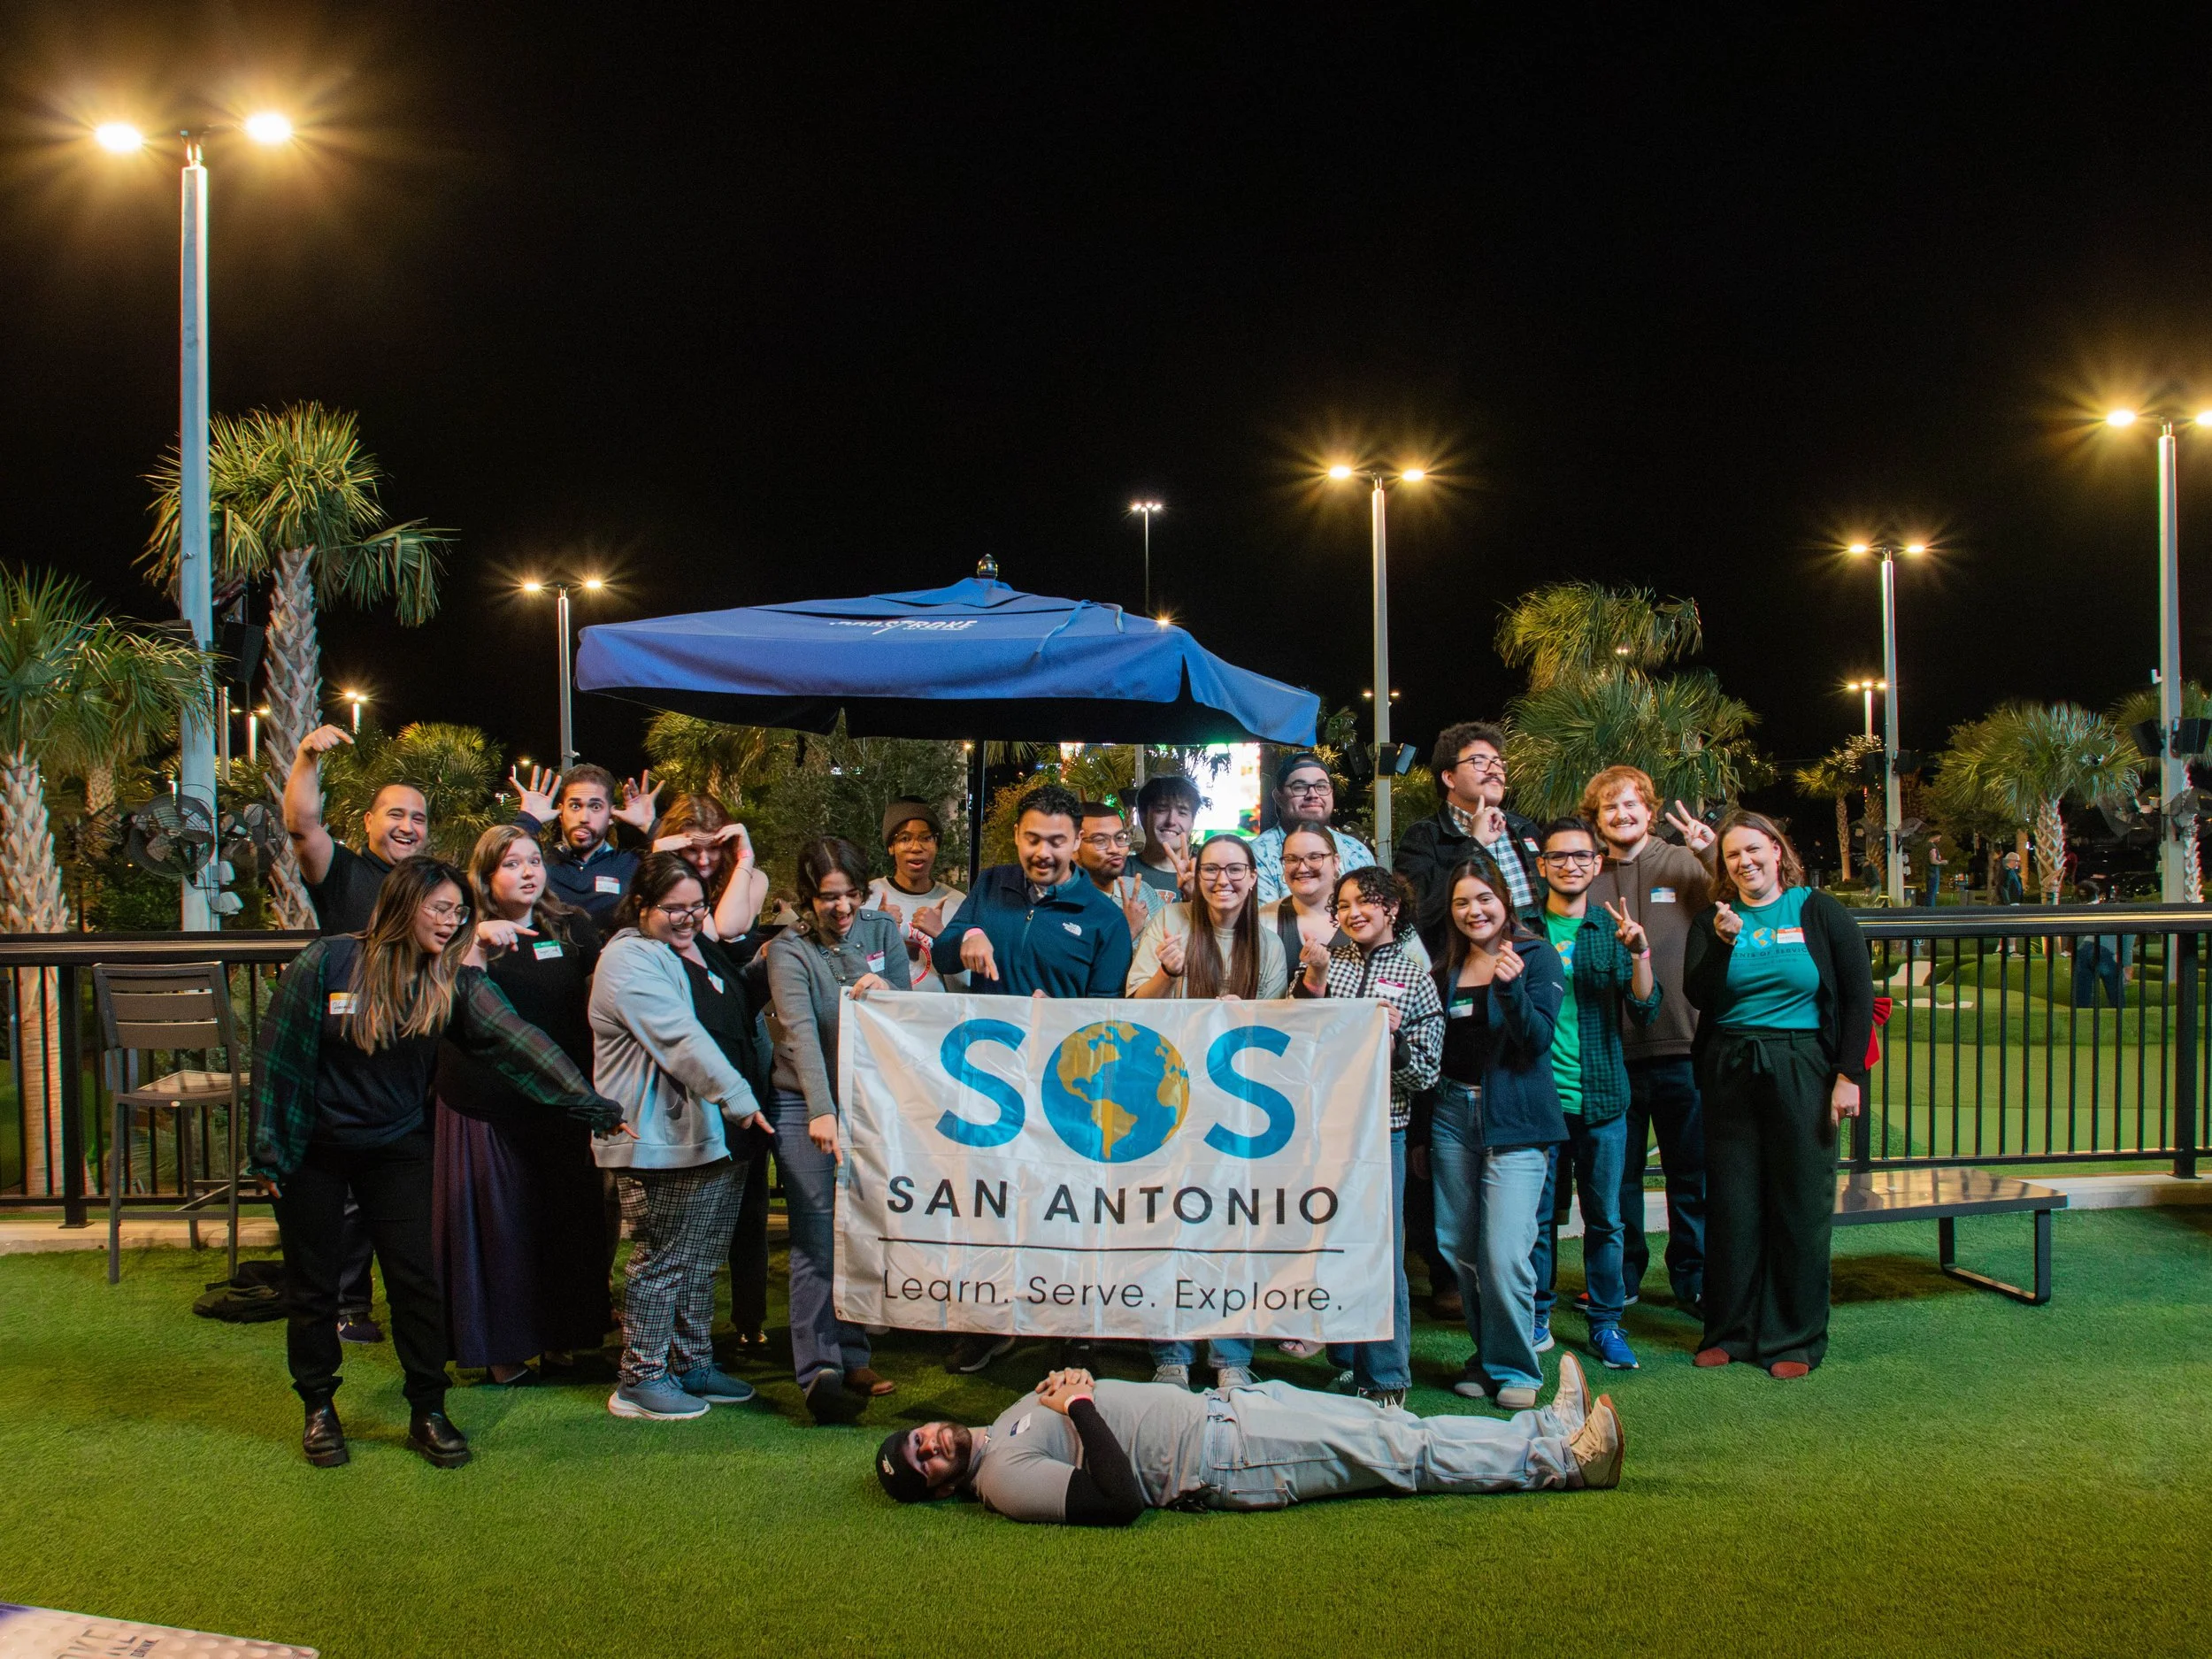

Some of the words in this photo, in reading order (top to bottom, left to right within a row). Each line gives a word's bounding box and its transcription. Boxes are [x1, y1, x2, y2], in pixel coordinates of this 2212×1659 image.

[935, 1018, 1295, 1164] SOS
[887, 1176, 1008, 1218] SAN
[1044, 1184, 1339, 1225] ANTONIO
[884, 1269, 1009, 1304] Learn.
[1027, 1276, 1156, 1309] Serve.
[1175, 1279, 1343, 1317] Explore.
